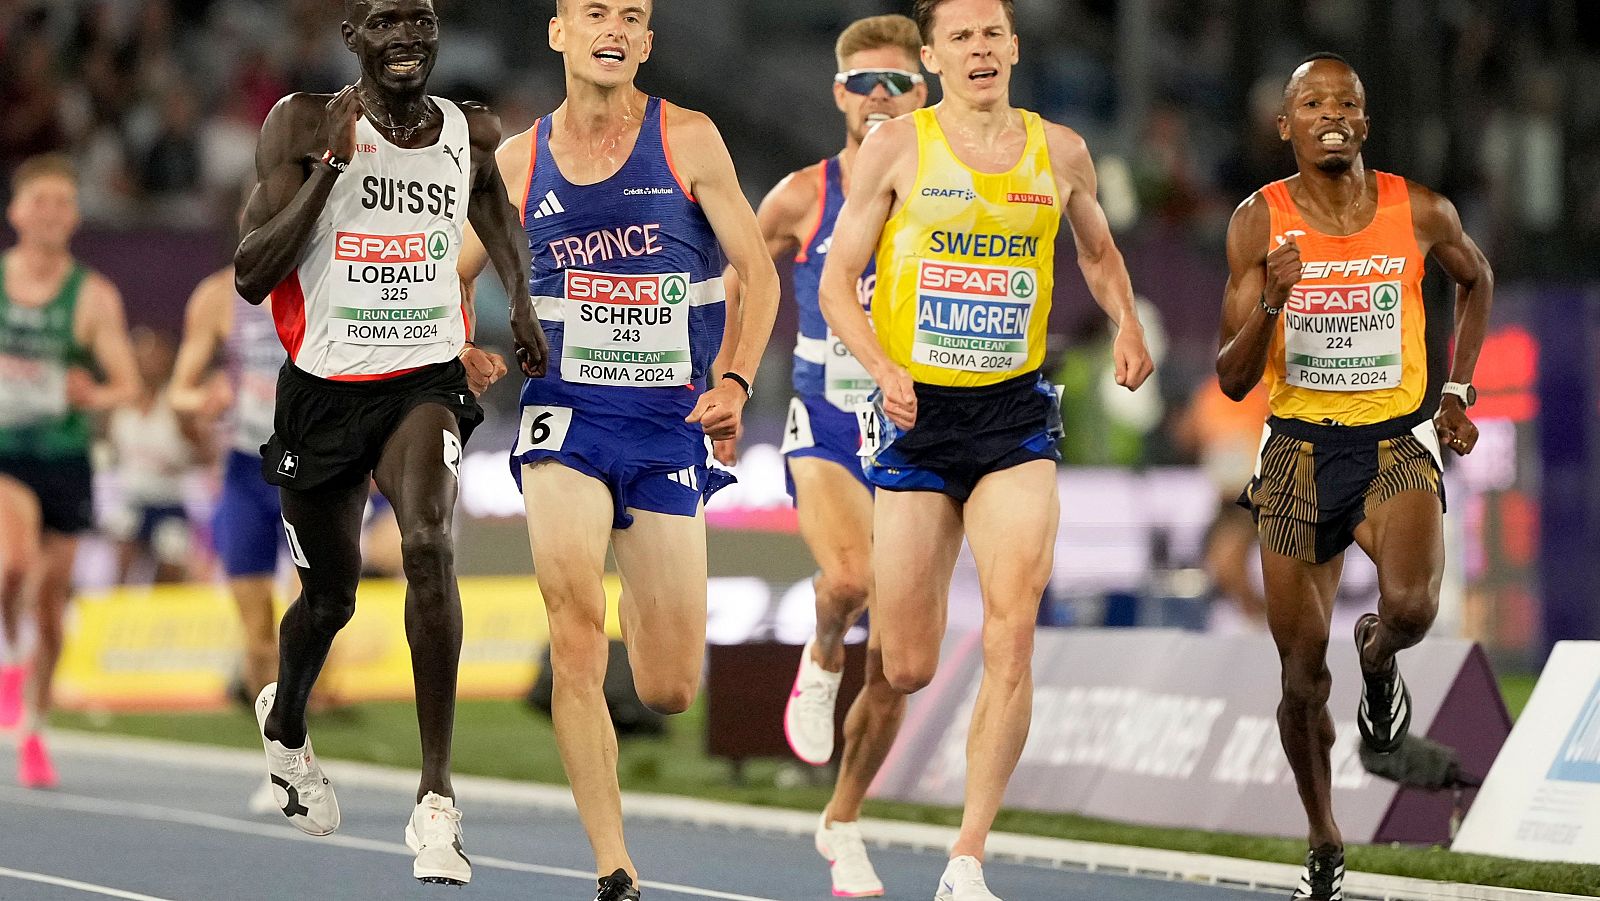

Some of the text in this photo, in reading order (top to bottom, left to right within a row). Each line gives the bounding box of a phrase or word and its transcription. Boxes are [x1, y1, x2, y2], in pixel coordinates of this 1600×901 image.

[356, 143, 377, 153] UBS
[651, 187, 673, 195] Mutuel
[921, 187, 965, 198] CRAFT
[1007, 193, 1053, 205] BAUHAUS
[338, 236, 424, 260] SPAR
[549, 223, 663, 269] FRANCE
[929, 230, 1039, 257] SWEDEN
[347, 263, 436, 284] LOBALU
[922, 267, 1006, 293] SPAR
[381, 287, 408, 301] 325
[569, 277, 657, 302] SPAR
[1287, 289, 1369, 311] SPAR
[363, 310, 390, 320] RUN
[580, 304, 672, 326] SCHRUB
[918, 300, 1029, 335] ALMGREN
[1286, 312, 1395, 334] NDIKUMWENAYO
[347, 324, 438, 339] ROMA 2024
[612, 328, 641, 343] 243
[944, 337, 968, 349] RUN
[1326, 336, 1353, 349] 224
[594, 351, 620, 361] RUN
[929, 350, 1012, 369] ROMA 2024
[1312, 357, 1338, 368] RUN
[580, 364, 675, 382] ROMA 2024
[1300, 370, 1387, 385] ROMA 2024
[530, 411, 554, 445] 6
